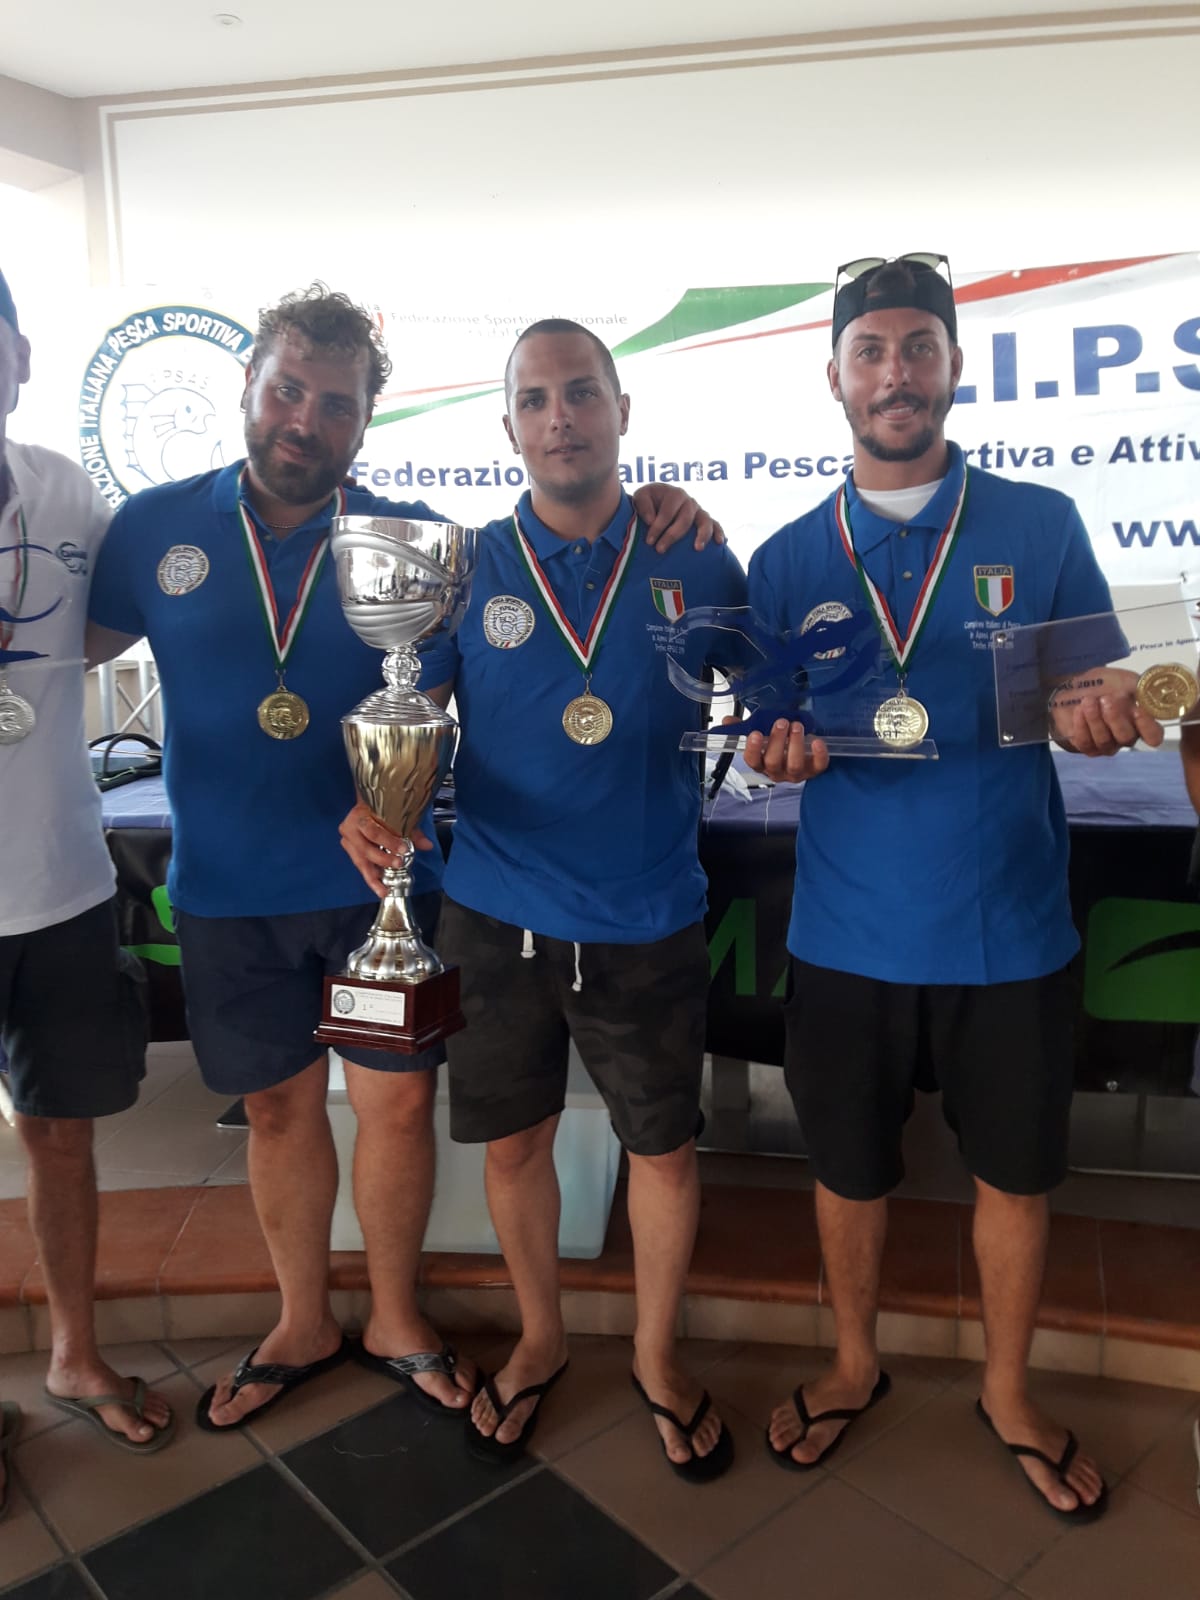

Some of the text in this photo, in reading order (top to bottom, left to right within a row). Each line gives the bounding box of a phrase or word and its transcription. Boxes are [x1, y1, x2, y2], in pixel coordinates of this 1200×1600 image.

[79, 352, 118, 428] ITALIANA
[108, 316, 160, 354] PESCA
[162, 312, 245, 352] SPORTIVA
[351, 460, 532, 487] Federazio
[1071, 445, 1095, 466] e
[978, 567, 1010, 576] ITALIA
[654, 580, 680, 589] ITALIA
